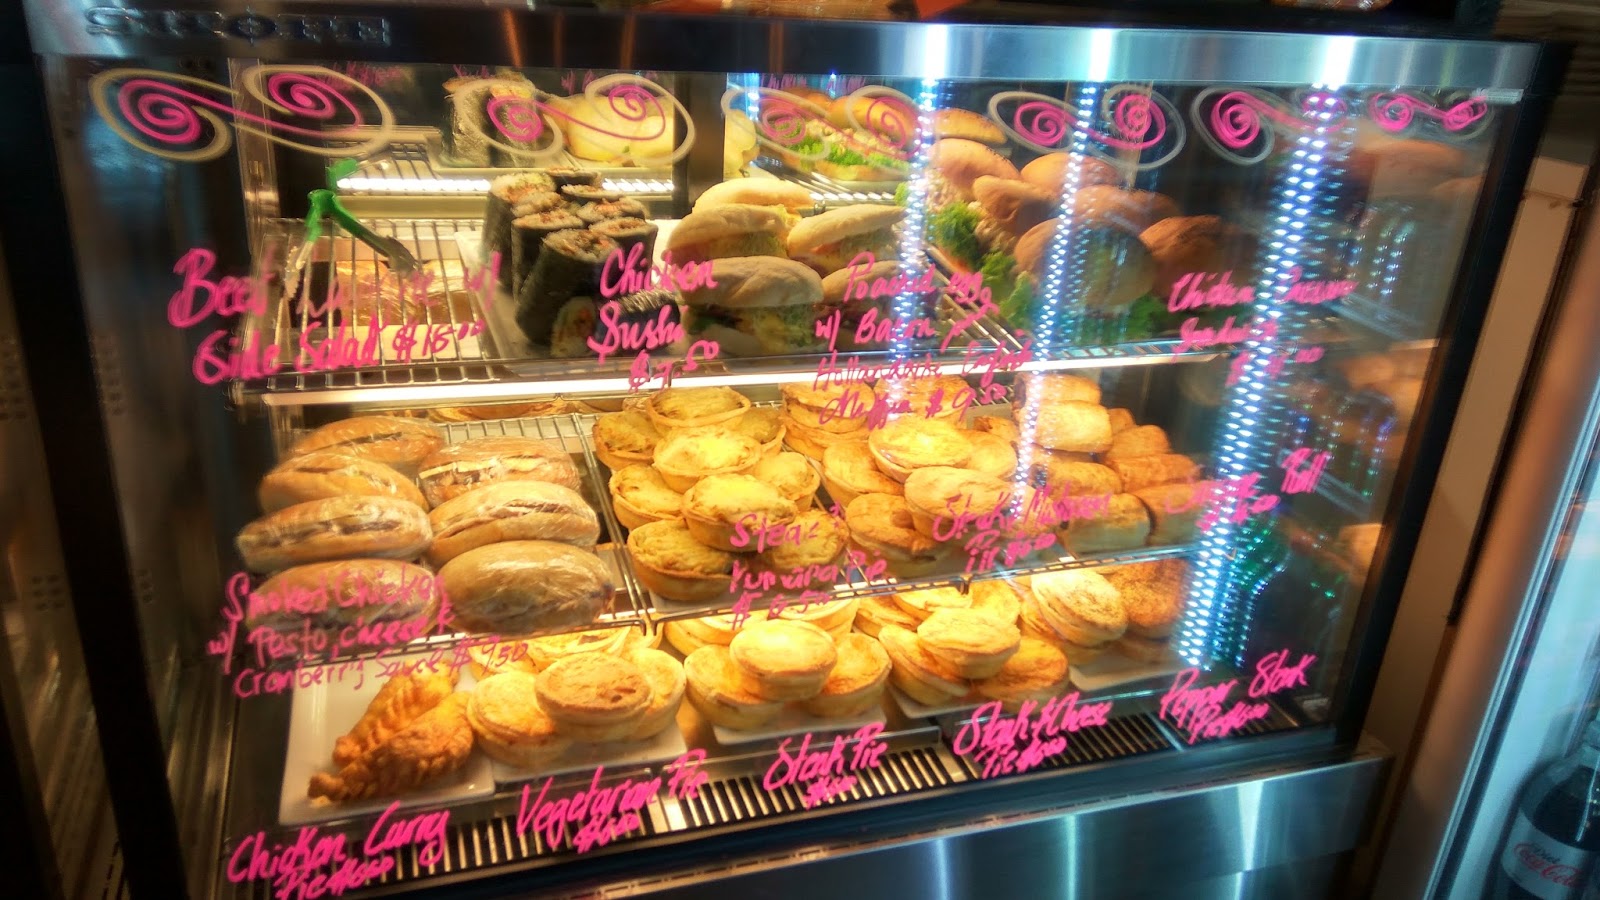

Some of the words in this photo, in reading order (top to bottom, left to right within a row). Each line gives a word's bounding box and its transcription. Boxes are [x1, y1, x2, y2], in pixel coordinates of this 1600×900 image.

[600, 241, 719, 298] Chicken
[294, 313, 387, 374] Salad
[586, 300, 690, 364] Sushi
[815, 309, 841, 351] w/
[221, 571, 329, 621] Smoked
[375, 645, 445, 679] Sauce
[850, 721, 888, 771] Pie
[516, 765, 662, 849] Vegetarian
[226, 830, 346, 883] Chicken
[362, 800, 450, 868] Curry
